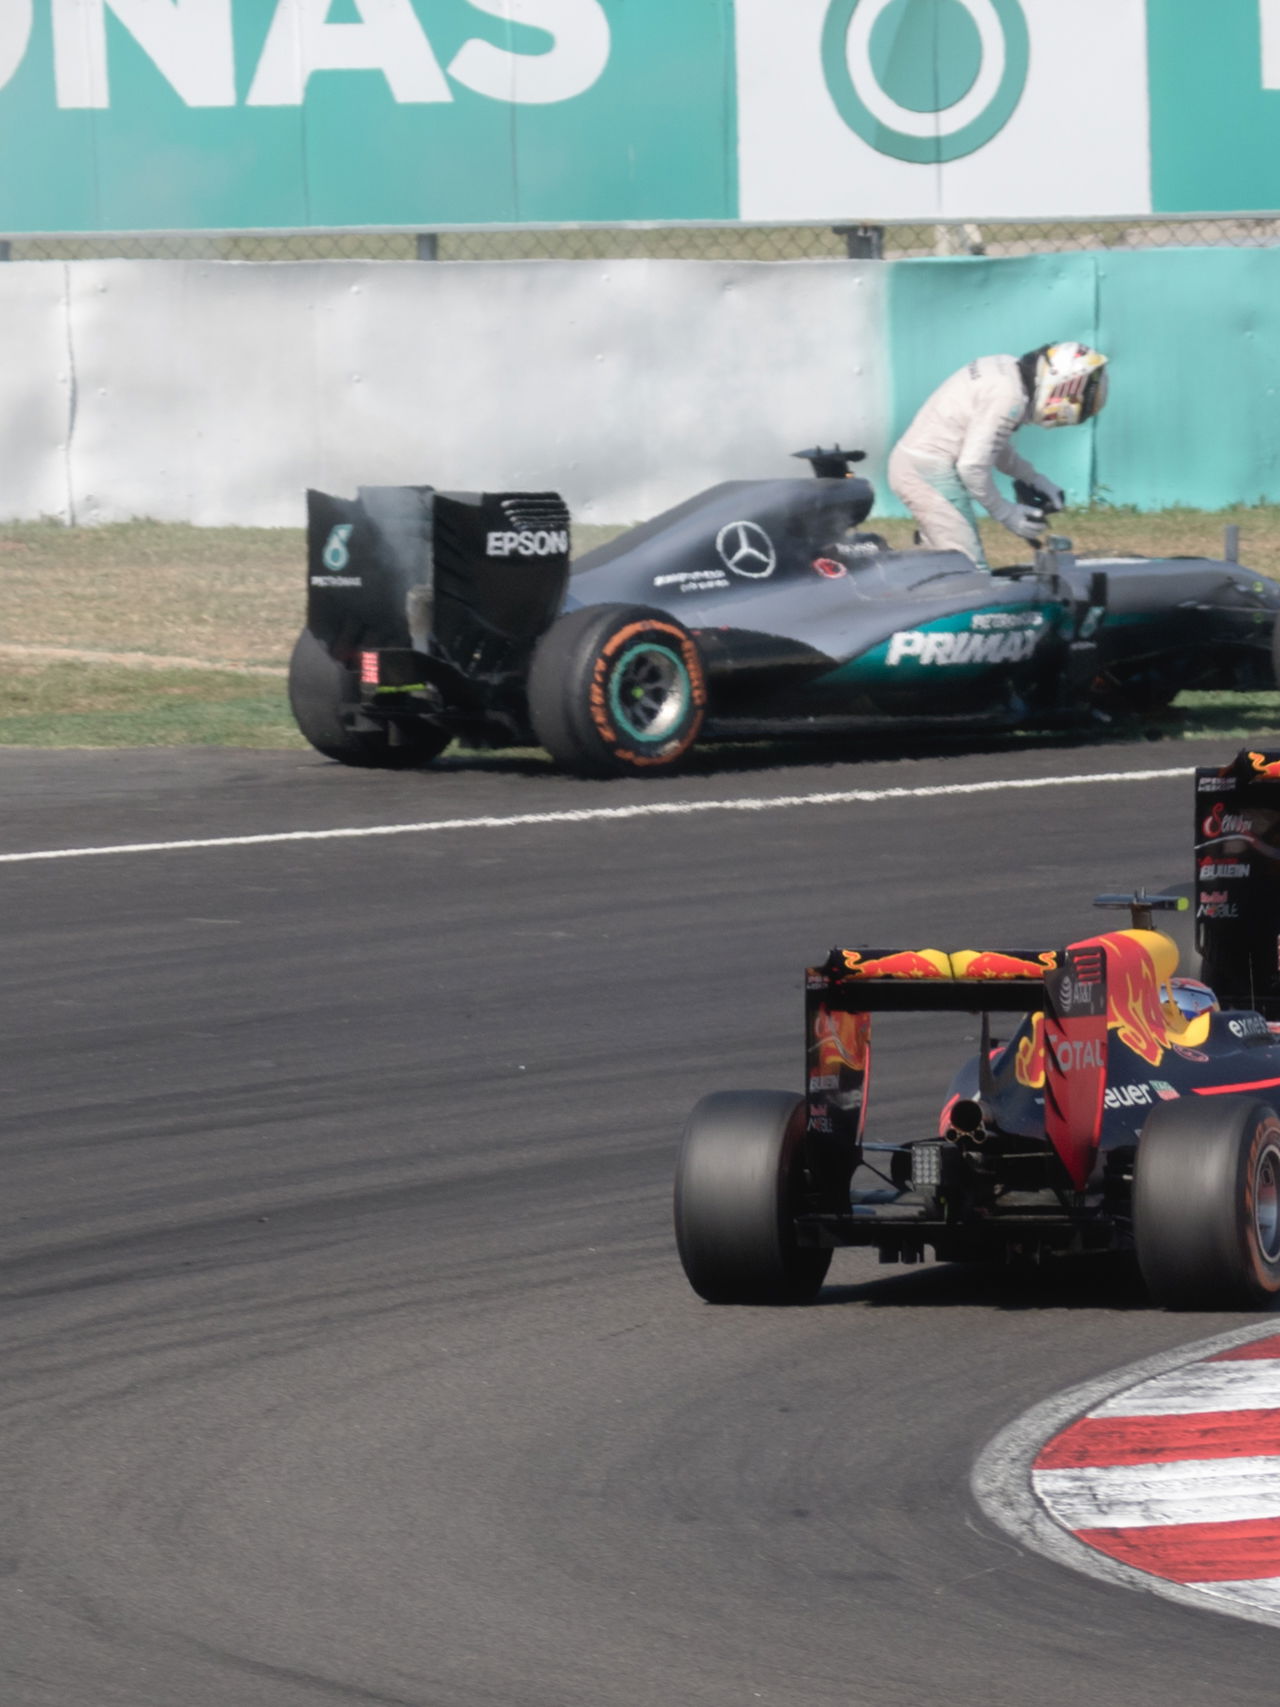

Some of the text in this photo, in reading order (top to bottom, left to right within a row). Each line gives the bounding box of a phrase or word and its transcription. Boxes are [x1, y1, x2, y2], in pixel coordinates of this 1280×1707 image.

[486, 531, 568, 557] EPSON
[1074, 982, 1092, 1004] AT&T
[1047, 1033, 1105, 1072] TOTAL
